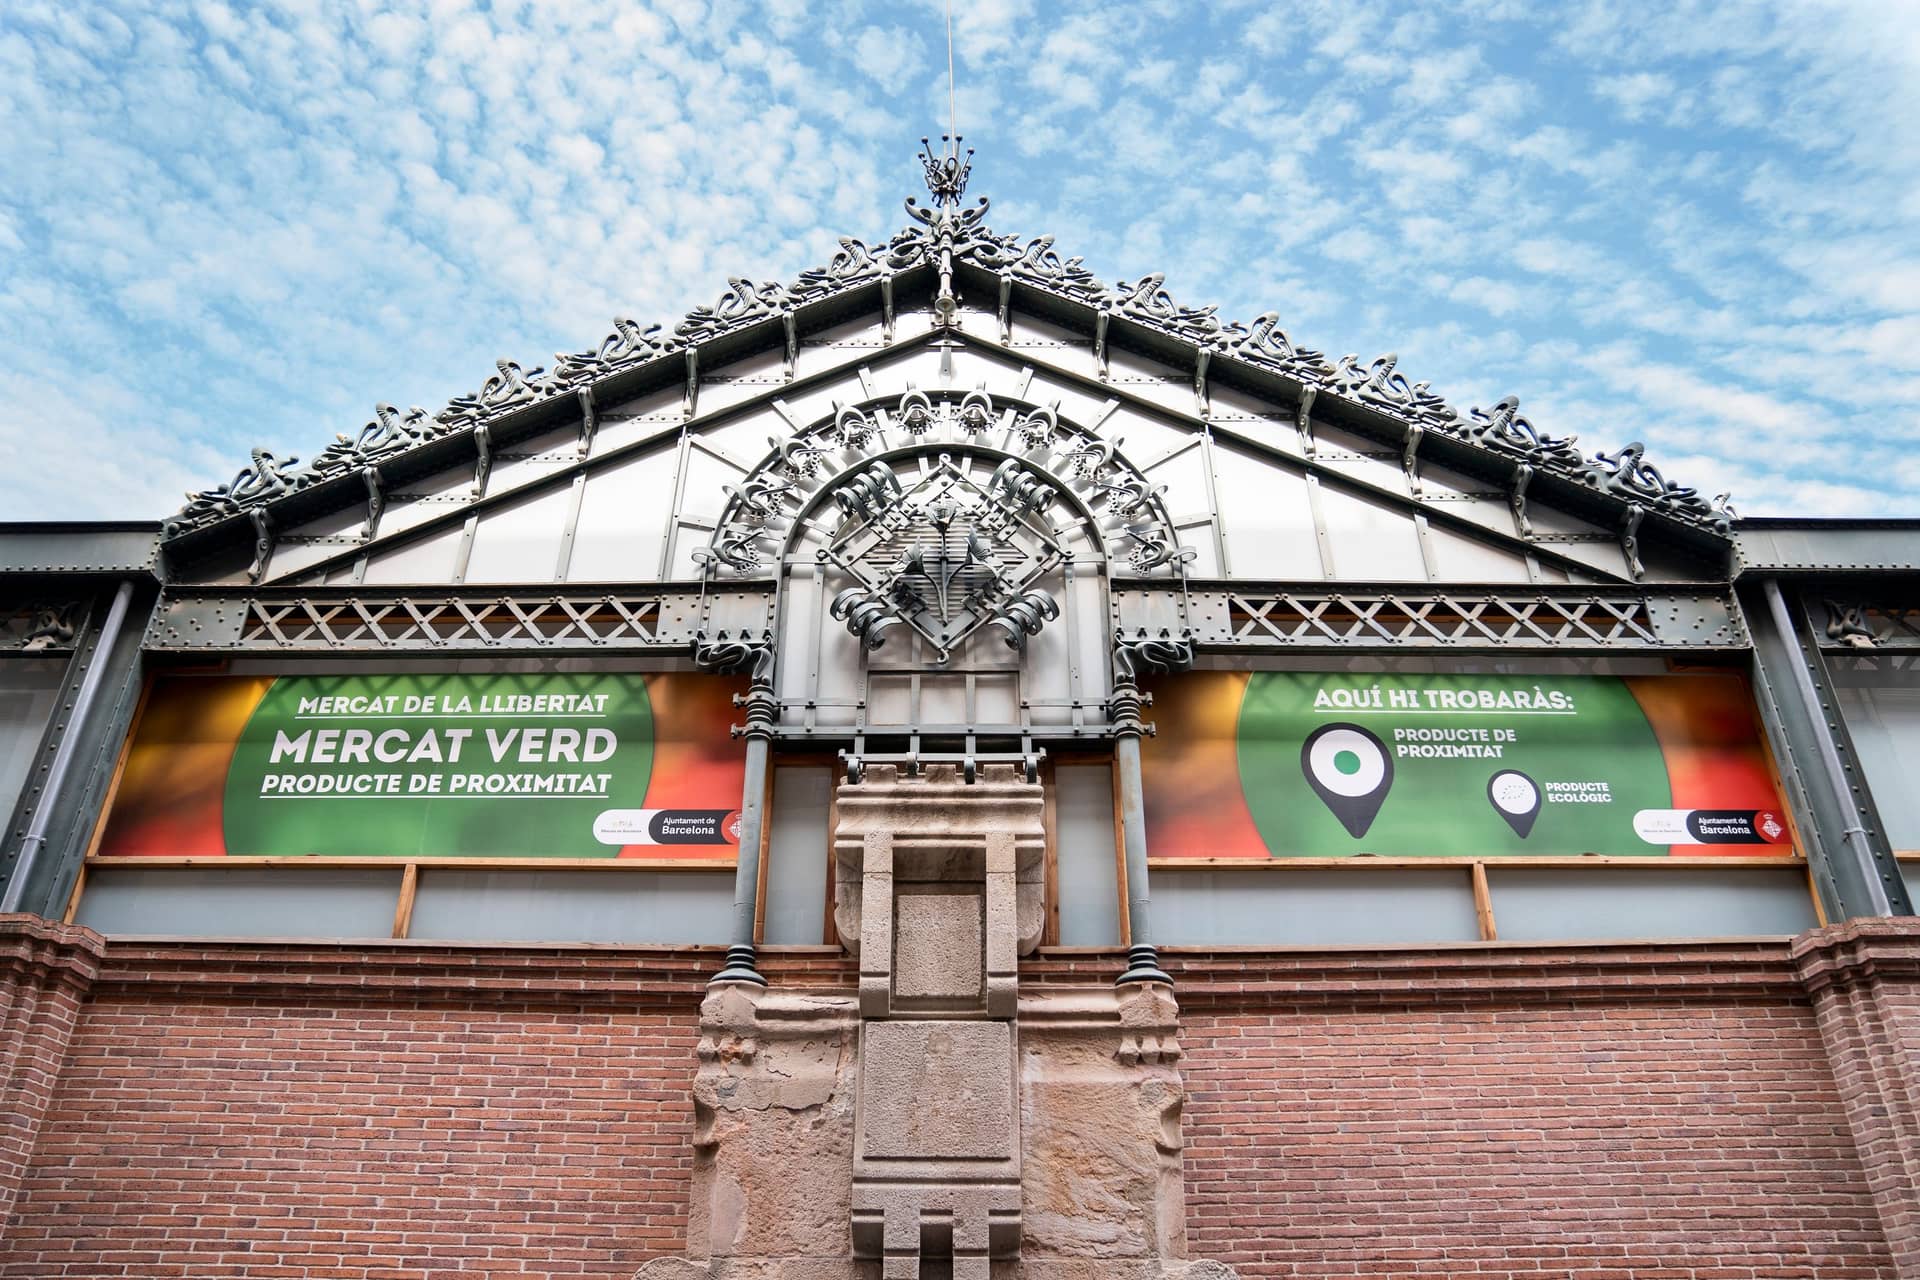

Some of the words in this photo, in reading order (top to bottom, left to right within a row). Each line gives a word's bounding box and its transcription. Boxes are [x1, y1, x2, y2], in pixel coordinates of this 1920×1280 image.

[1313, 684, 1385, 708] AQUÍ
[1388, 688, 1421, 709] HI
[1423, 685, 1575, 710] TROBARÀS:
[297, 695, 400, 714] MERCAT
[402, 695, 437, 713] DE
[441, 695, 473, 713] LA
[479, 694, 609, 713] LLIBERTAT
[1393, 728, 1490, 742] PRODUCTE
[1492, 728, 1517, 742] DE
[269, 729, 473, 763] MERCAT
[485, 728, 618, 763] VERD
[1396, 744, 1504, 758] PROXIMITAT
[260, 774, 403, 793] PRODUCTE
[408, 773, 444, 793] DE
[448, 773, 613, 793] PROXIMITAT
[1544, 781, 1610, 791] PRODUCTE
[1547, 789, 1613, 802] ECOLÒGIC
[663, 817, 705, 825] Ajuntament
[705, 817, 716, 825] de
[1698, 817, 1738, 825] Ajuntament
[1738, 817, 1748, 825] de
[661, 825, 715, 835] Barcelona
[1700, 825, 1751, 835] Barcelona
